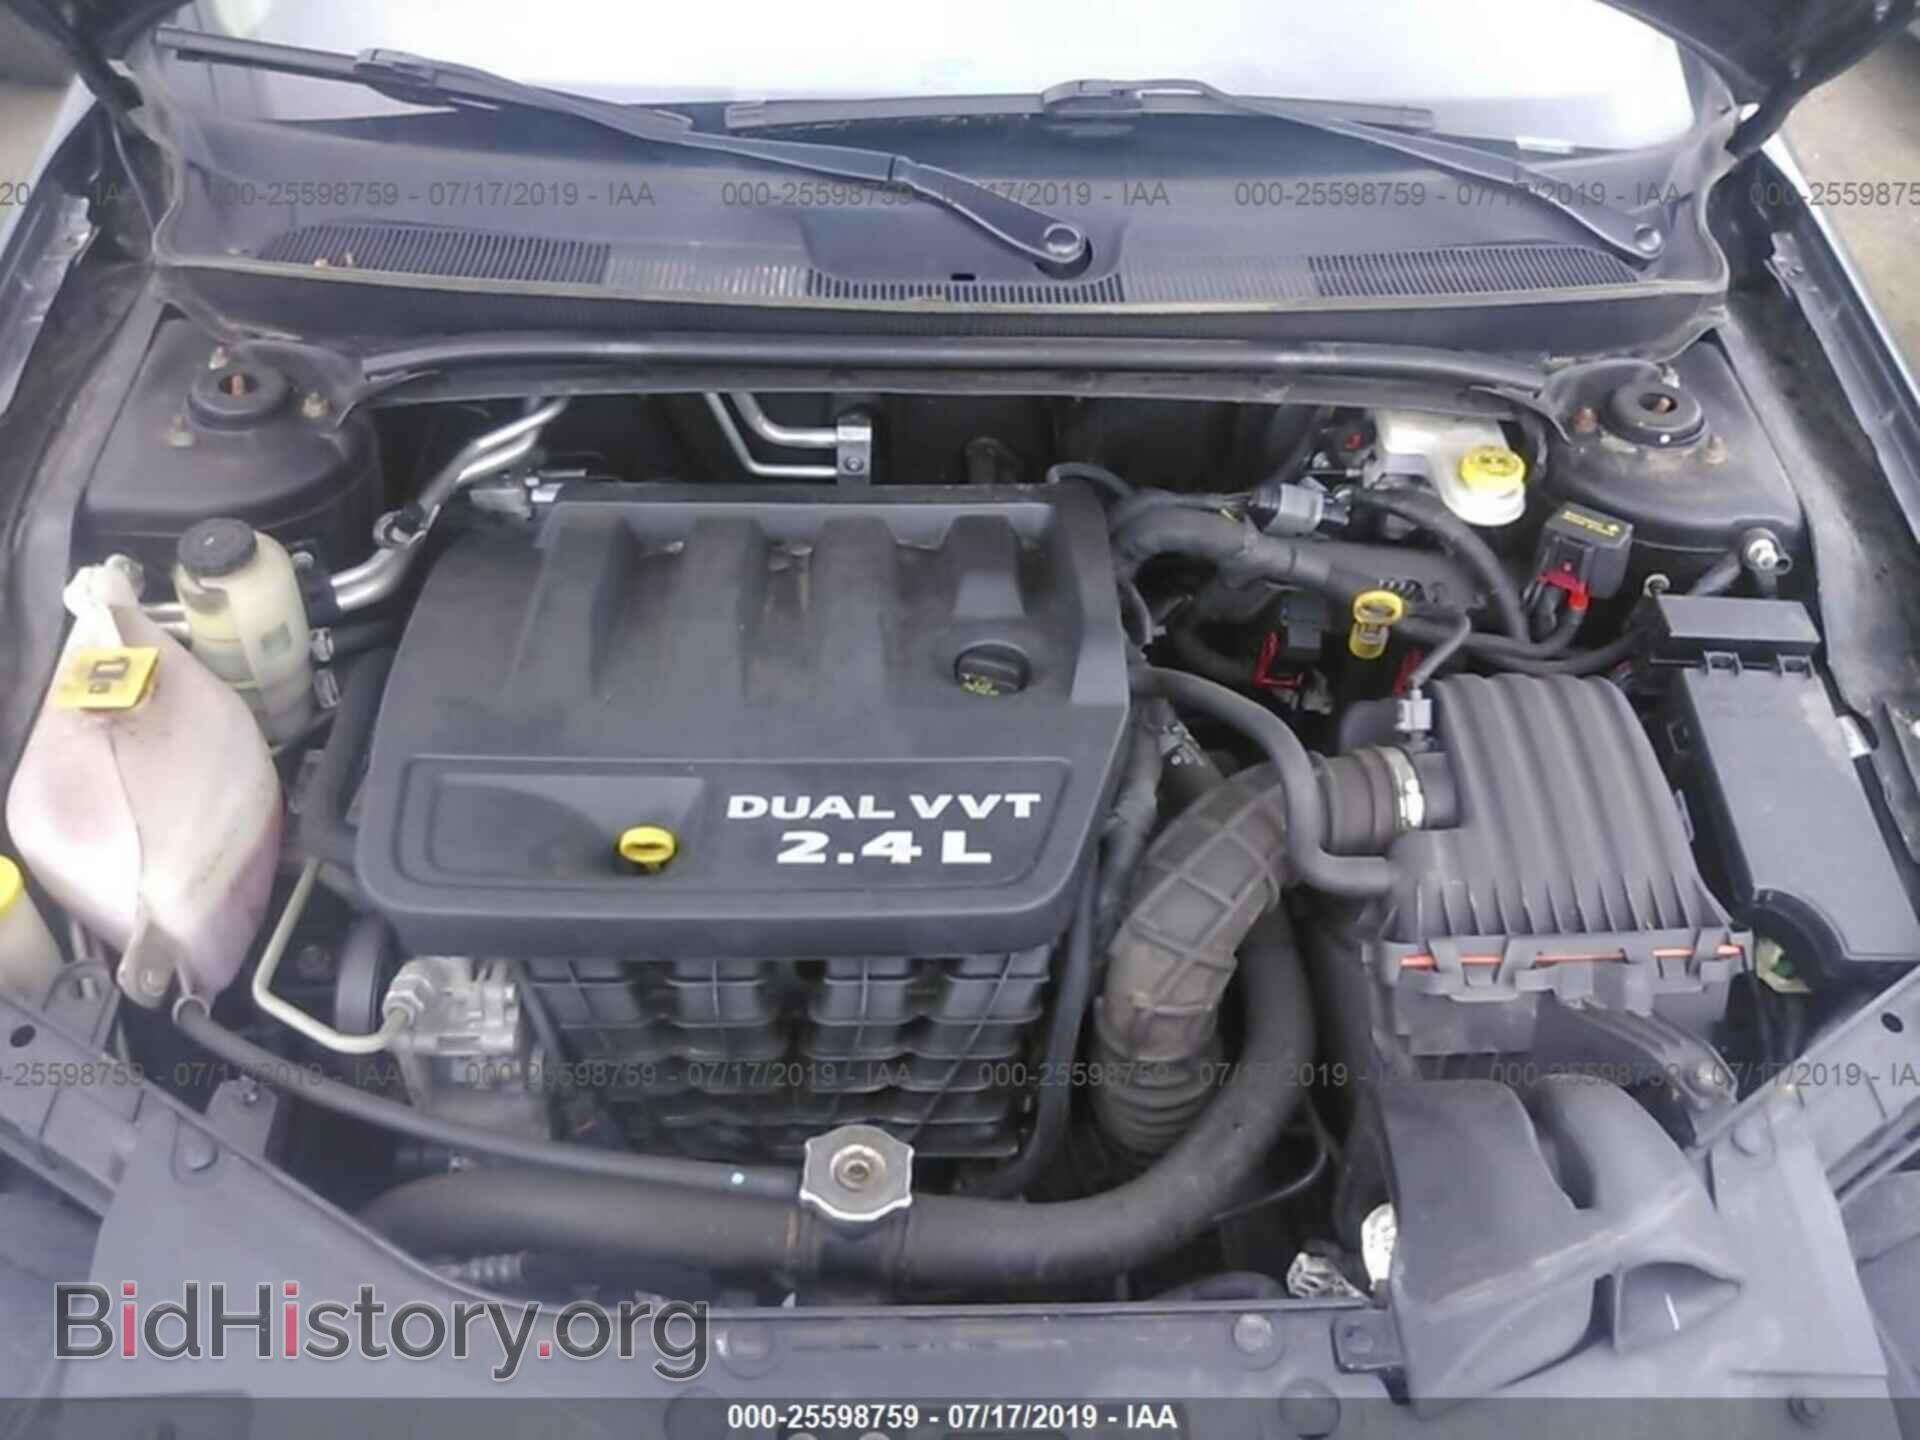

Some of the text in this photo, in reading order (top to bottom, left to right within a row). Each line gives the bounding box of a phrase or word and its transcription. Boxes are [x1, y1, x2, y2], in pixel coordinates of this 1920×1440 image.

[727, 793, 1042, 819] DUAL VVT
[776, 830, 992, 864] 2.4 L
